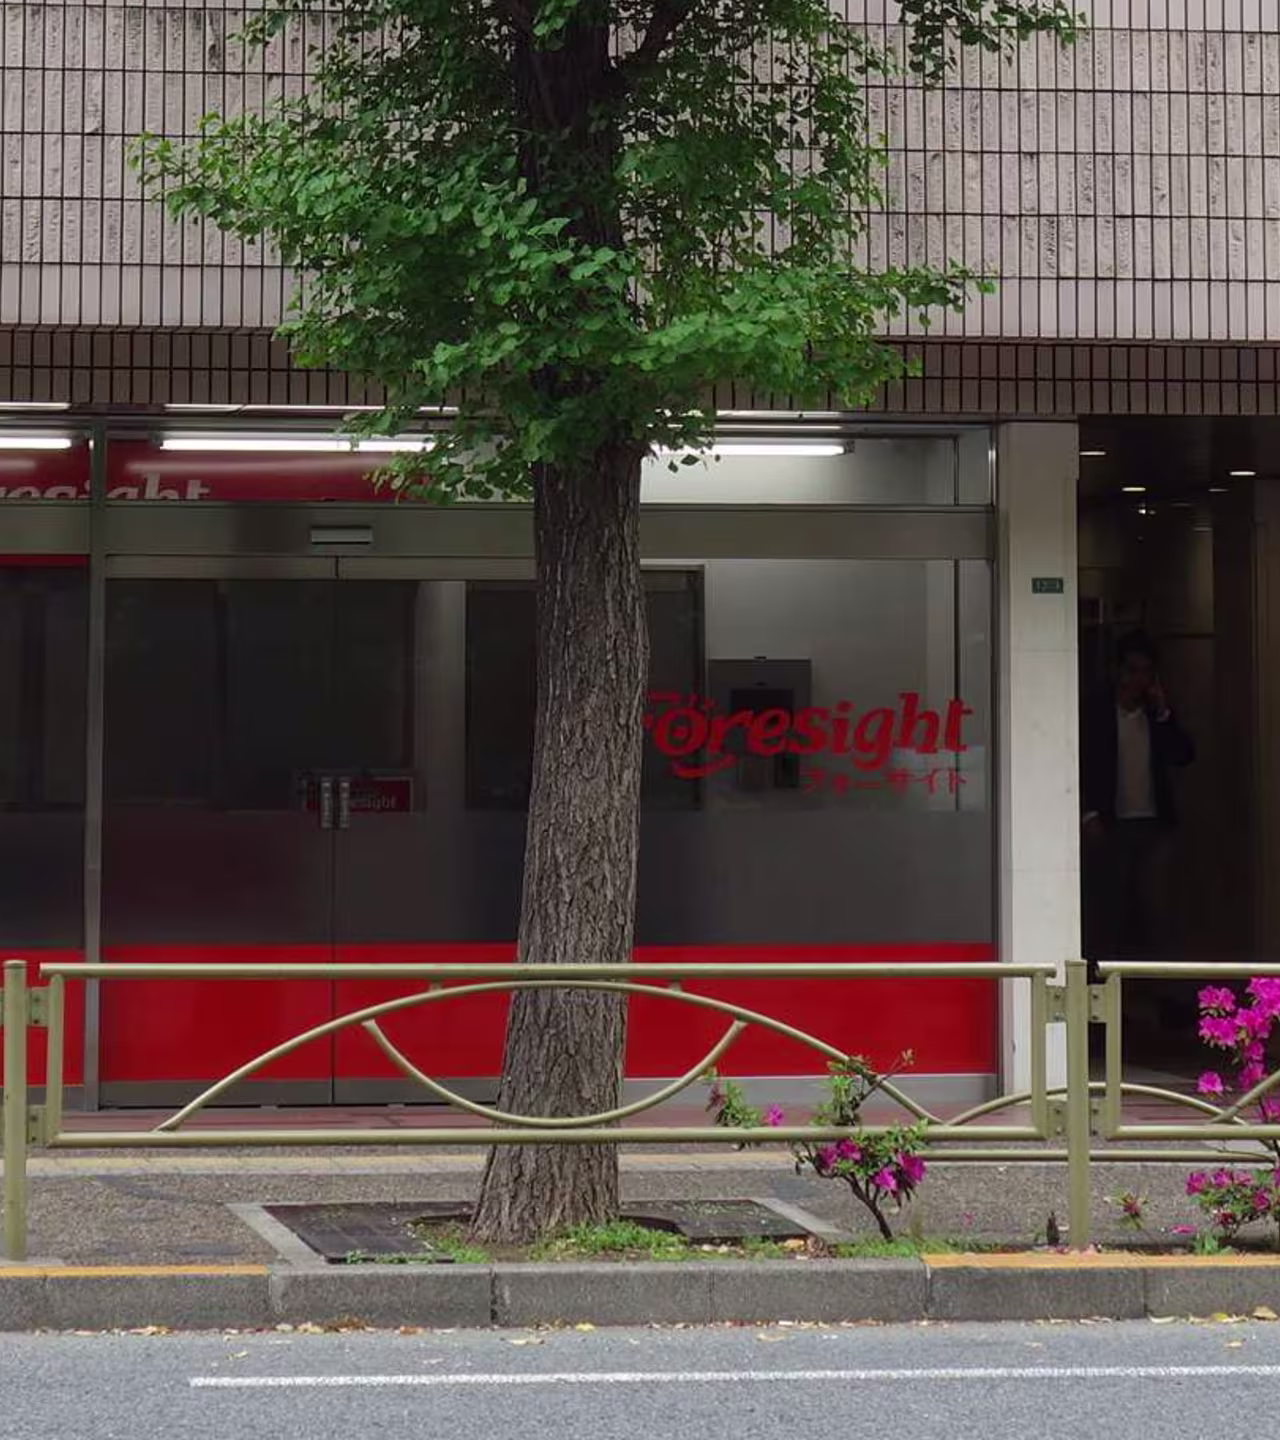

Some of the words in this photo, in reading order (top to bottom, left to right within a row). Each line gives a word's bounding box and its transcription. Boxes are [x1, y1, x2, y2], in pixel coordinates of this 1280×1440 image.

[642, 690, 975, 773] oresight
[801, 769, 969, 795] フォーサイト
